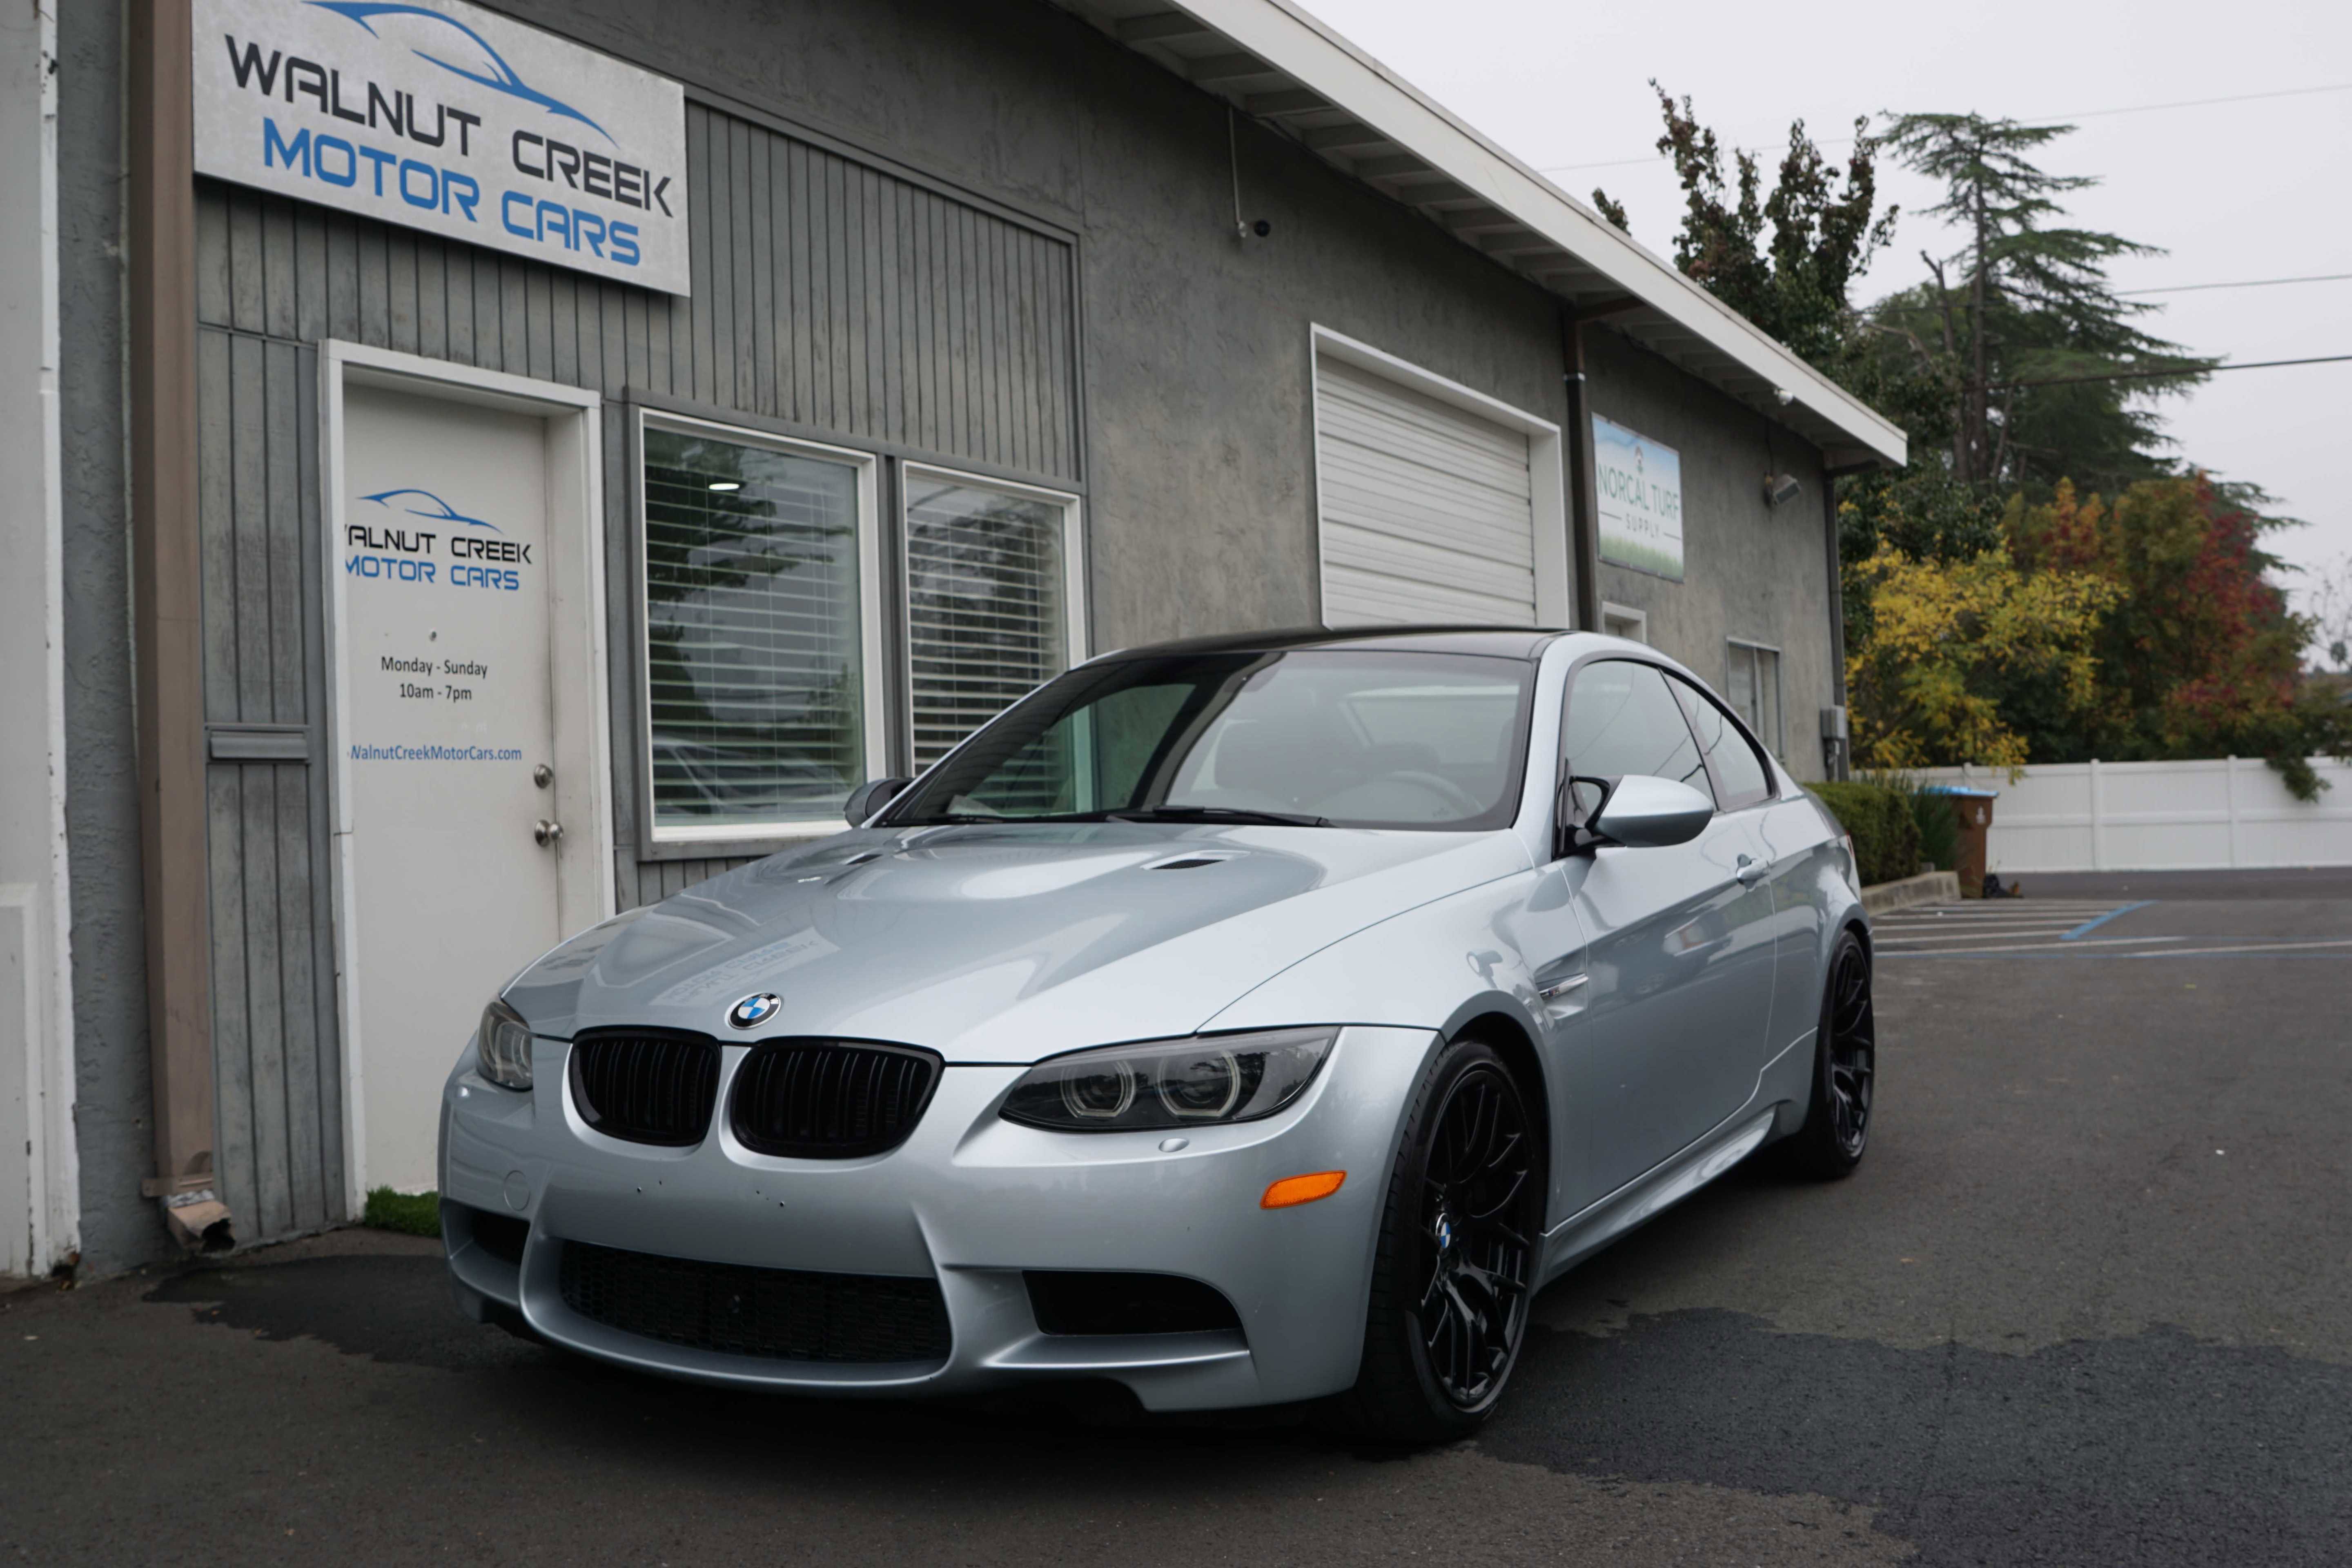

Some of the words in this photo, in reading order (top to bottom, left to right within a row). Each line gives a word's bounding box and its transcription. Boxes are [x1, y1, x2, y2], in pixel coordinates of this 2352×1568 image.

[224, 33, 481, 157] WALNUT
[512, 129, 674, 218] CREEK
[263, 117, 480, 223] MOTOR
[501, 190, 641, 266] CARS
[1598, 463, 1650, 511] NORCAL
[1651, 483, 1679, 520] TURF
[1626, 513, 1659, 539] SUPPLY
[345, 523, 436, 554] ALNUT
[451, 537, 532, 564] CREEK
[450, 565, 519, 591] CARS
[381, 655, 433, 676] Monday
[444, 659, 488, 679] Sunday
[400, 683, 434, 699] 10am
[445, 684, 472, 703] 7pm
